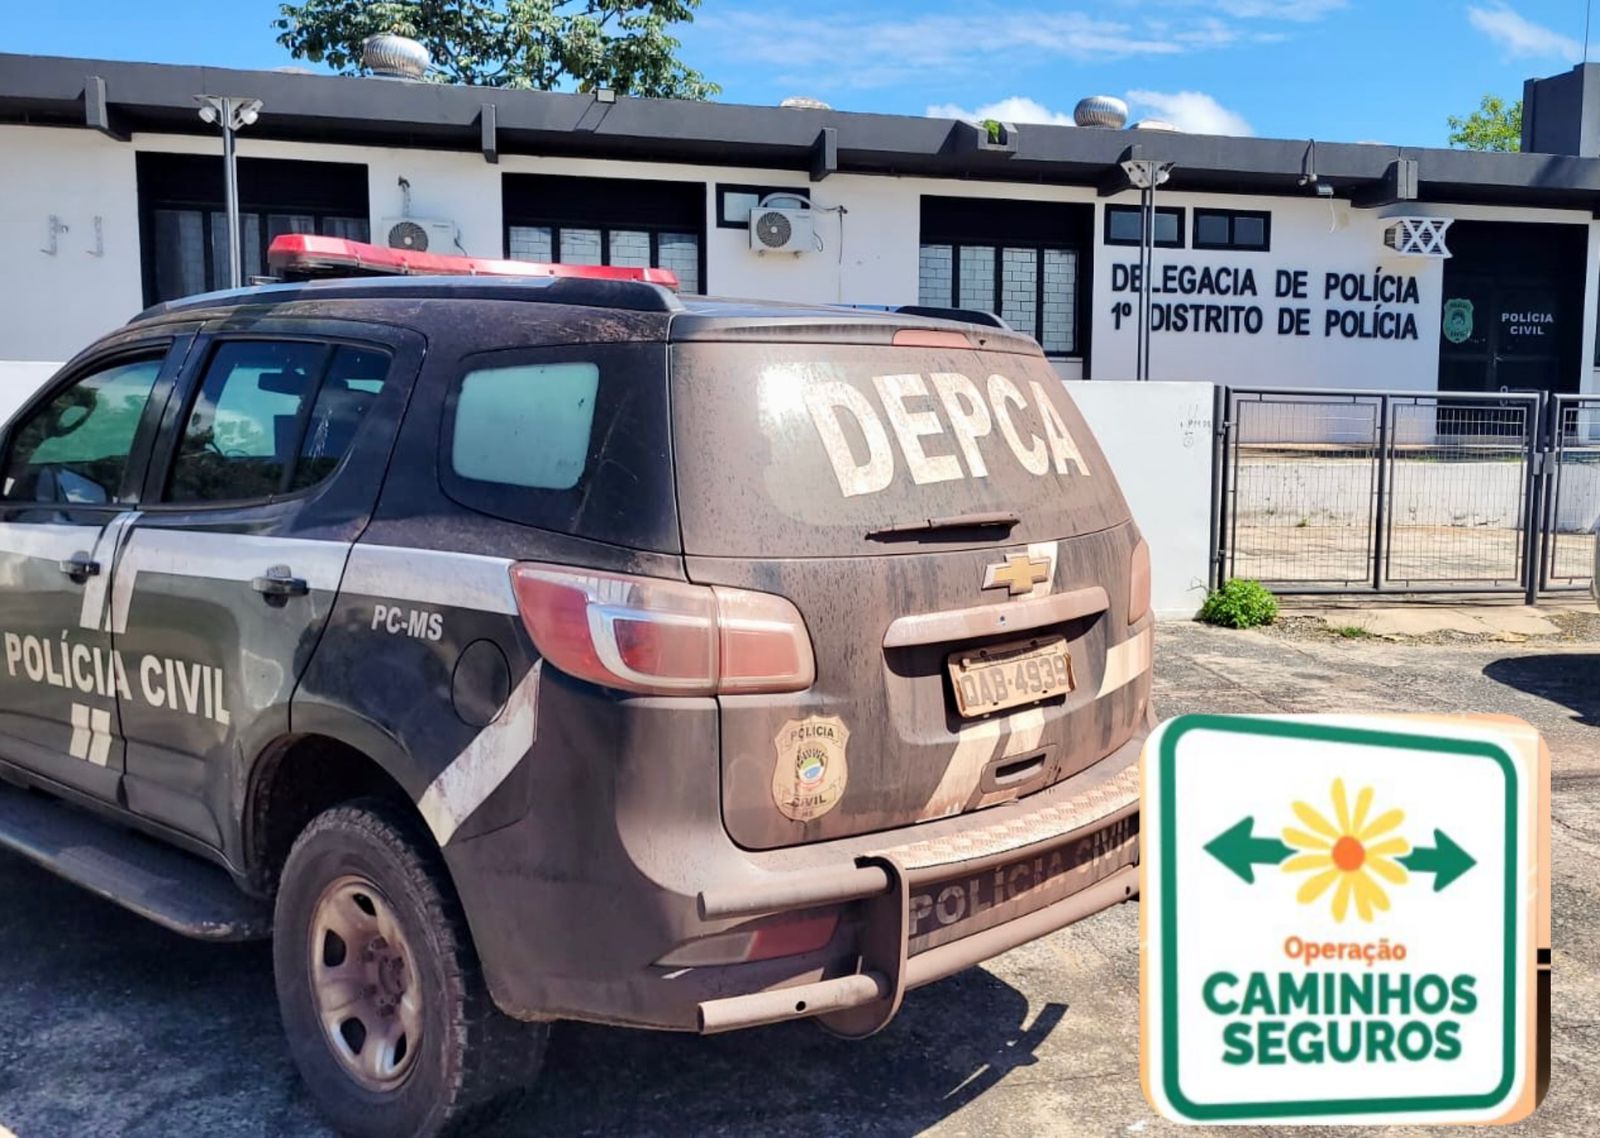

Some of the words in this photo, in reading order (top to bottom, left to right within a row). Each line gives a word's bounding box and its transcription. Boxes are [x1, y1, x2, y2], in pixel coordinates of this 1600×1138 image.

[1111, 263, 1257, 296] DEEGACIA
[1275, 270, 1308, 298] DE
[1325, 266, 1419, 304] POLÍCIA
[1111, 301, 1132, 331] 1º
[1151, 303, 1263, 334] DISTRITO
[1278, 308, 1310, 336] DE
[1325, 304, 1418, 340] POLÍCIA
[1501, 311, 1554, 323] POLÍCIA
[1510, 325, 1544, 335] CIVIL
[804, 372, 1091, 498] DEPCA
[371, 604, 443, 641] PC-MS
[4, 629, 132, 700] POLÍCIA
[140, 654, 230, 725] CIVIL
[792, 794, 827, 808] CIVIL
